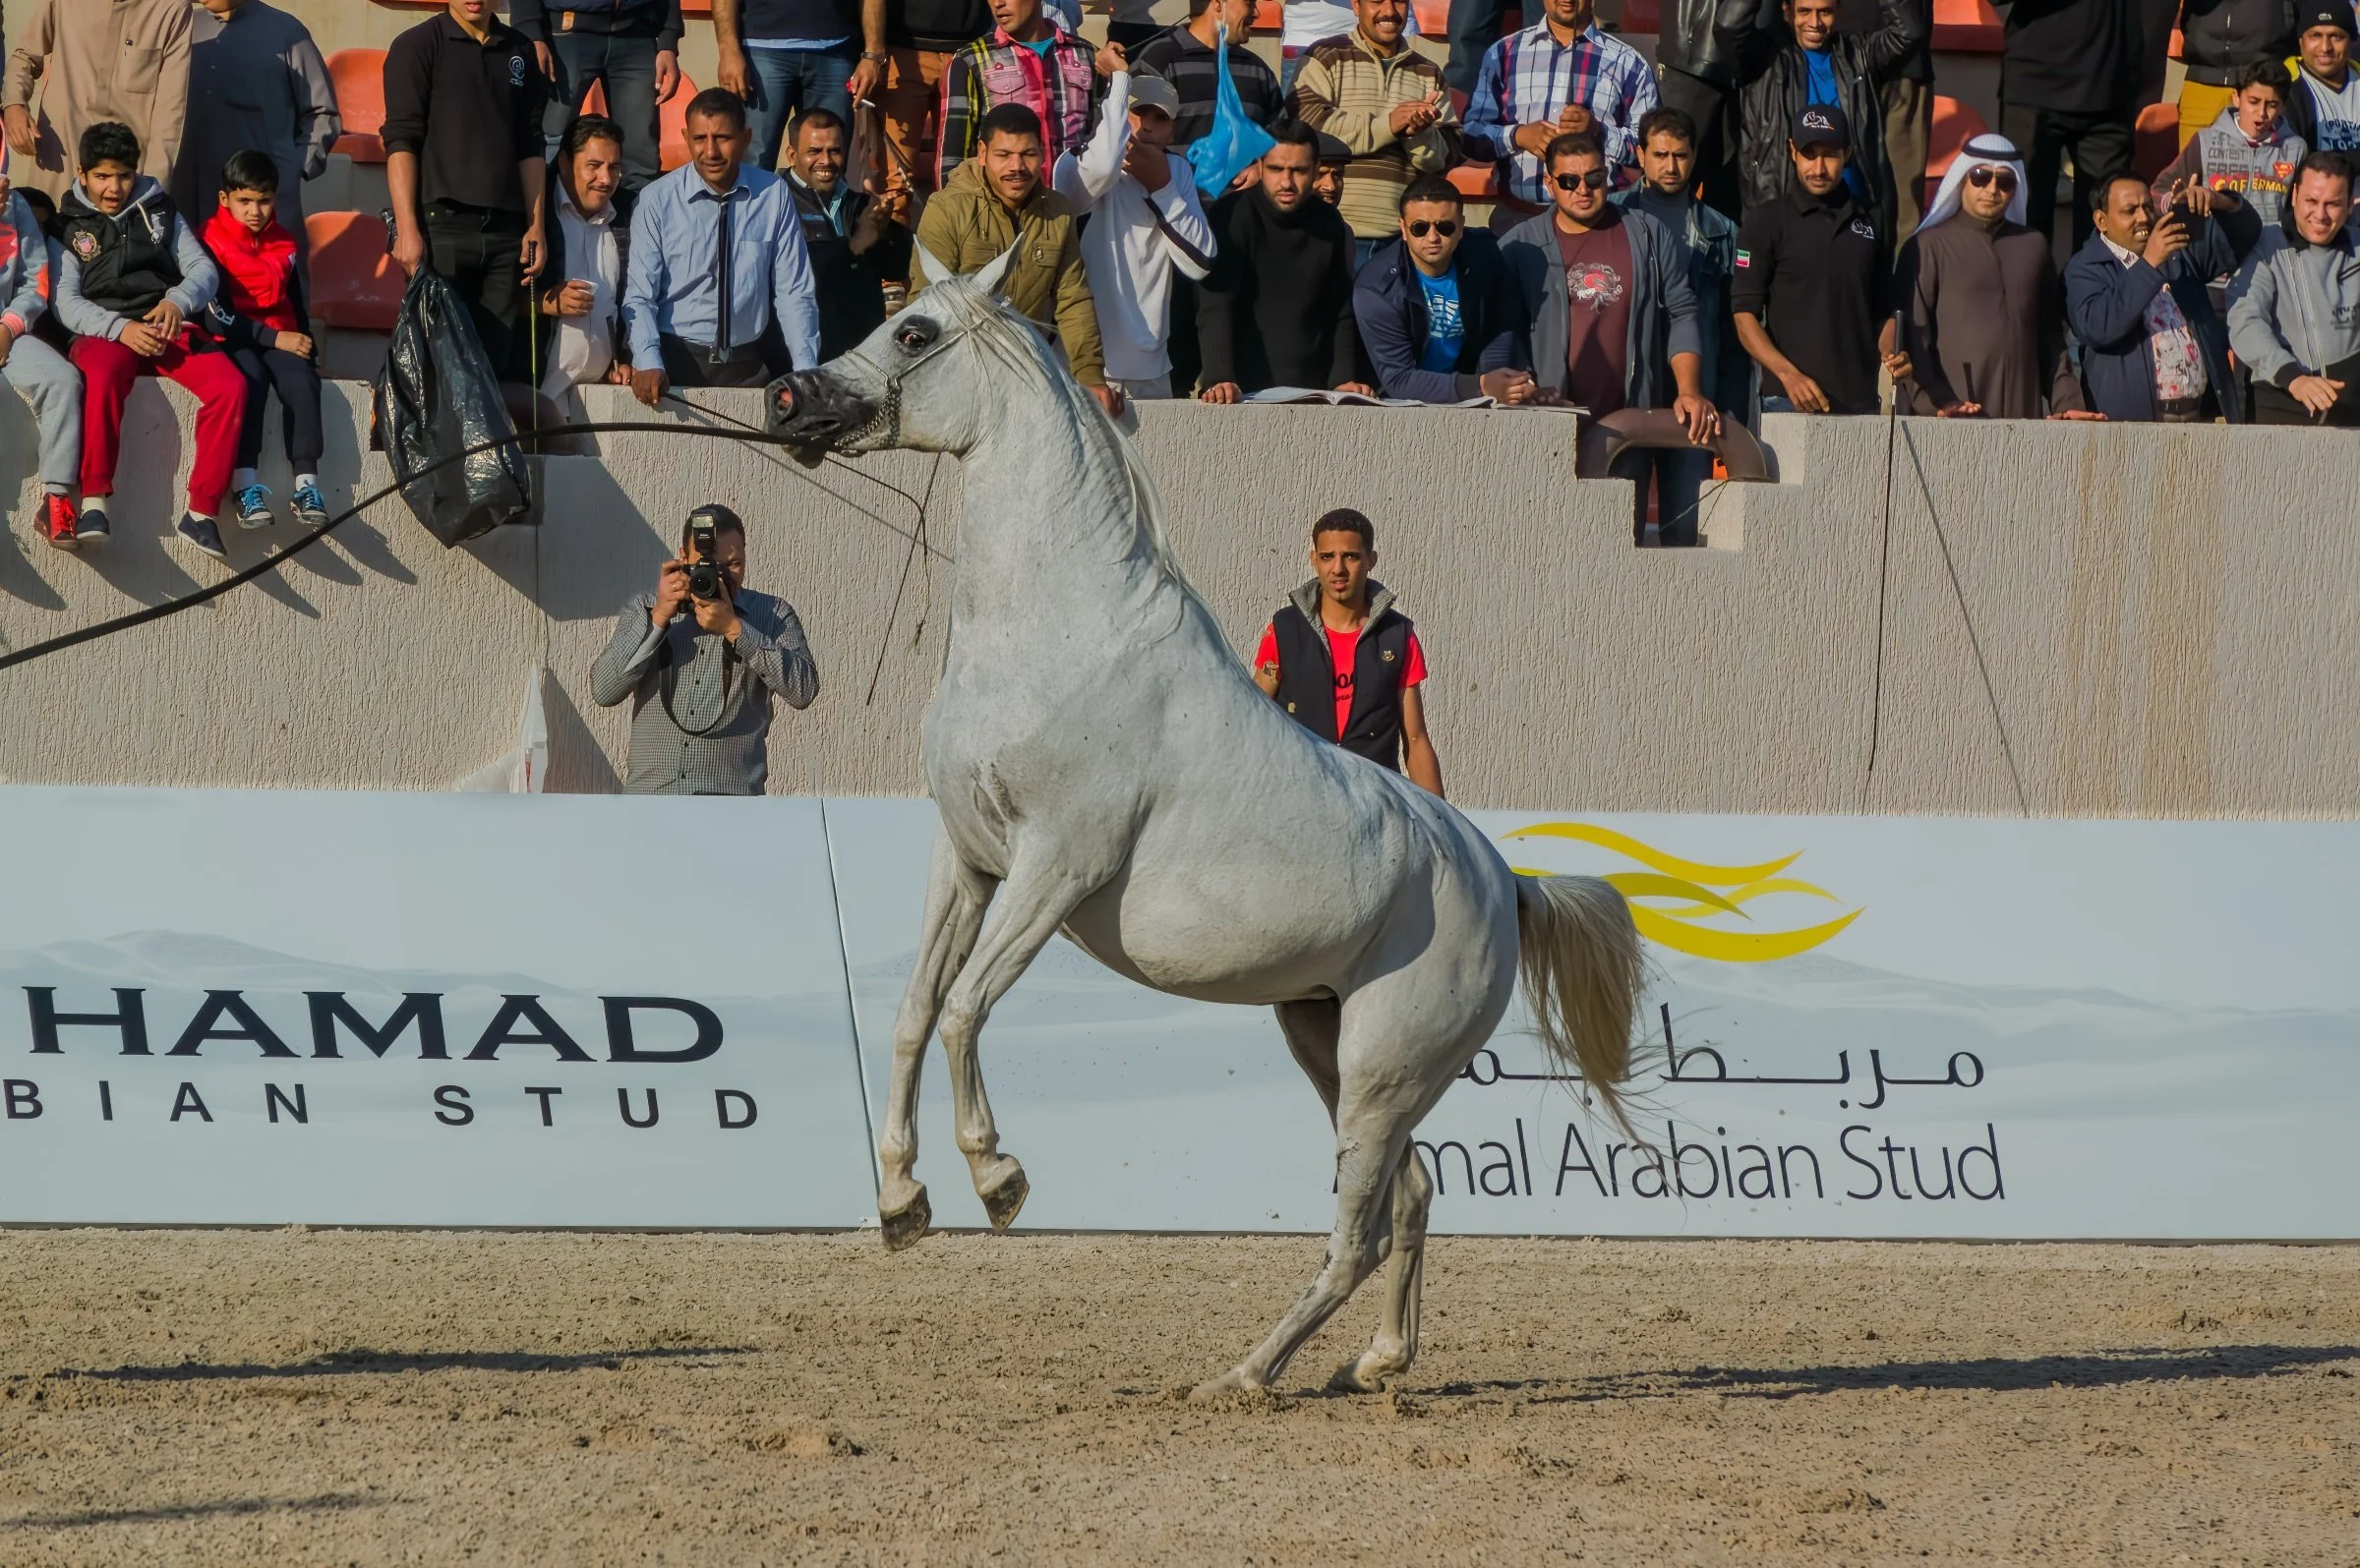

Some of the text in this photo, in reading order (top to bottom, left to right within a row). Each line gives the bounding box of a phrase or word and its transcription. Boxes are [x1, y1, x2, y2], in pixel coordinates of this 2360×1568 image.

[22, 986, 724, 1064] HAMAD
[1660, 1001, 1984, 1111] مربط
[3, 1078, 758, 1130] BIAN STUD
[1332, 1118, 2006, 1201] mal Arabian Stud
